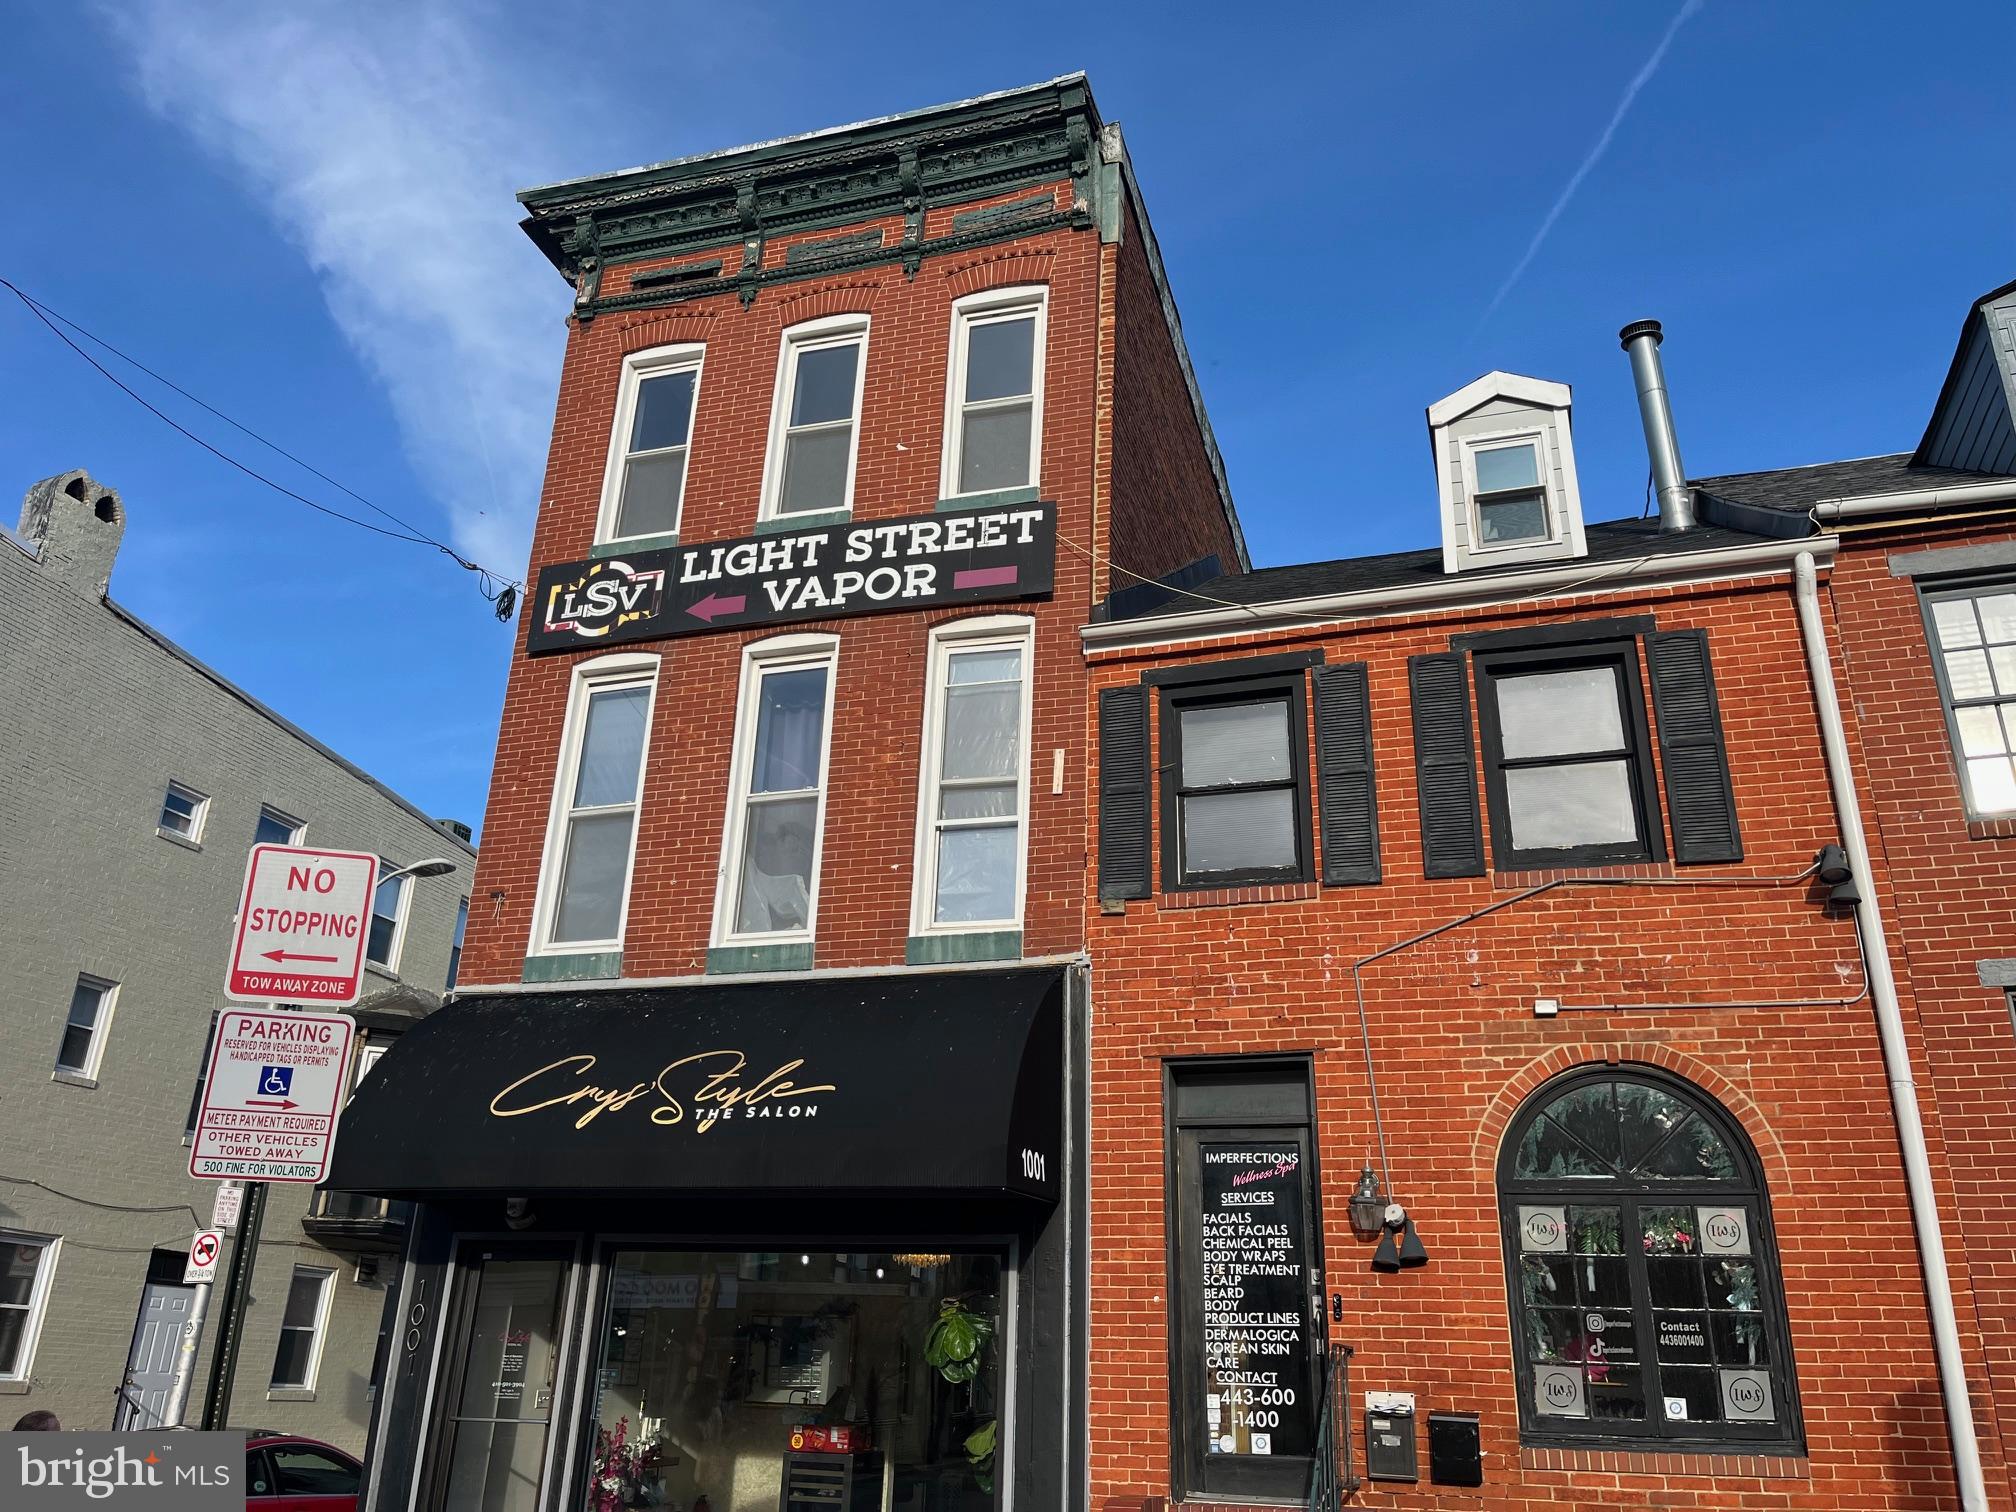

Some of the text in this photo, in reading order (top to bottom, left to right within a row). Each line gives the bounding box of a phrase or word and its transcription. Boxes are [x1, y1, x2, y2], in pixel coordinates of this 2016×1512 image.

[679, 509, 1044, 584] LIGHT STREET
[762, 563, 936, 612] VAPOR
[562, 577, 648, 619] LSV
[287, 866, 336, 894] NO
[250, 907, 358, 939] STOPPING
[242, 976, 346, 995] TOW AWAY ZONE
[237, 1020, 332, 1043] PARKING
[224, 1039, 339, 1056] RESERVED FOR VEHICLES DISPLAYING
[230, 1051, 329, 1067] HANDICAPPED TAGS OR PERMITS
[651, 1050, 836, 1134] Style
[695, 1104, 819, 1121] THE SALON
[207, 1113, 327, 1131] METER PAYMENT REQUIRED
[208, 1131, 318, 1147] OTHER VEHICLES
[219, 1145, 304, 1159] TOWED AWAY
[1205, 1152, 1299, 1164] IMPERFECTIONS
[203, 1161, 317, 1177] 500 FINE FOR VIOLATORS
[1021, 1148, 1047, 1183] 1001
[1232, 1161, 1296, 1187] Wellness Spa
[1220, 1191, 1275, 1204] SERVICES
[1203, 1212, 1252, 1224] FACIALS
[1203, 1224, 1288, 1237] BACK FACIALS
[1202, 1237, 1294, 1249] CHEMICAL PEEL
[1203, 1250, 1286, 1262] BODY WRAPS
[1203, 1263, 1301, 1276] EYE TREATMENT
[1203, 1275, 1242, 1286] SCALP
[1204, 1287, 1244, 1299] BEARD
[1205, 1300, 1239, 1312] BODY
[1205, 1312, 1300, 1325] PRODUCT LINES
[1660, 1321, 1700, 1332] Contact
[407, 1279, 425, 1376] 1001
[1205, 1329, 1300, 1341] DERMALOGICA
[1205, 1342, 1290, 1355] KOREAN SKIN
[1660, 1334, 1704, 1347] 4436001400
[1206, 1357, 1239, 1369] CARE
[1216, 1370, 1278, 1384] CONTACT
[1220, 1388, 1295, 1406] 443-600
[1232, 1410, 1280, 1428] -1400
